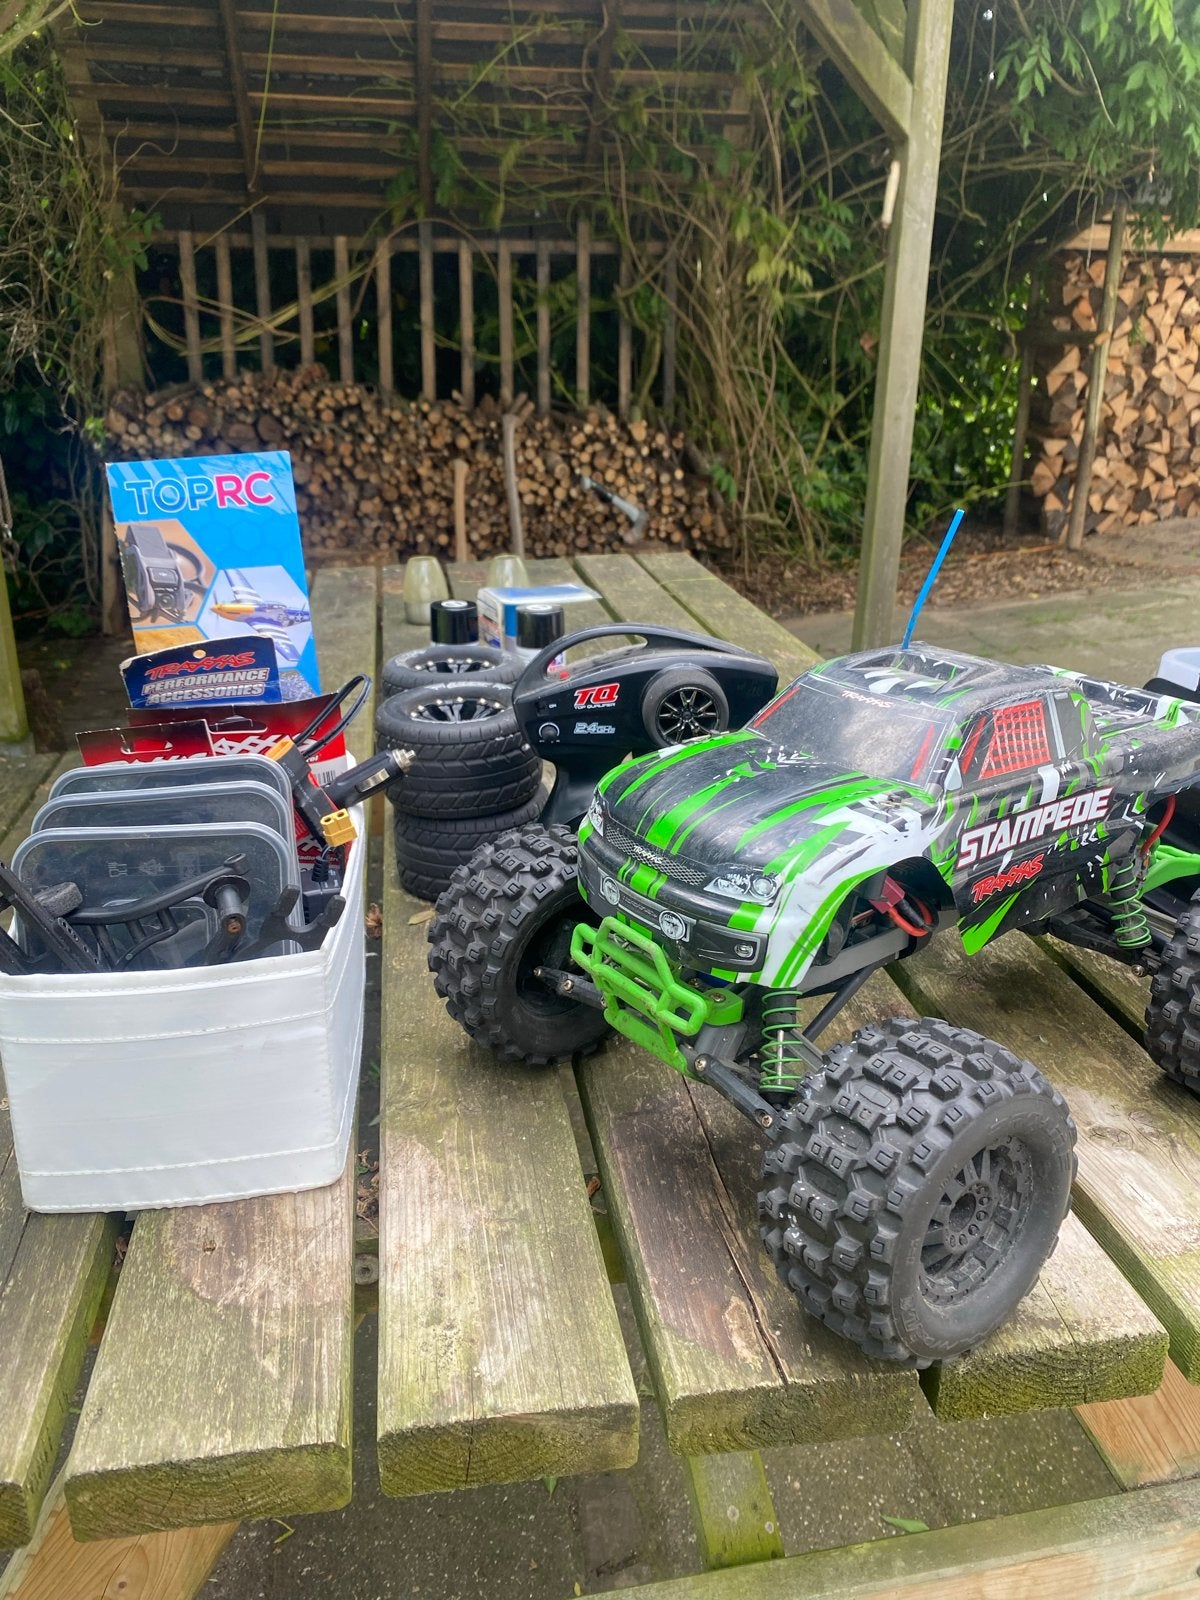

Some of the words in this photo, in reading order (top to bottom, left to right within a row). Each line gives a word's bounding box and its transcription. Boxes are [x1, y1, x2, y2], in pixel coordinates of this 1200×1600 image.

[125, 471, 275, 514] TOPRC
[145, 652, 256, 680] TRAXXAS
[142, 668, 270, 695] PERFORMANCE
[146, 683, 265, 706] ACCESSORIES
[573, 683, 620, 705] TQ
[841, 689, 894, 709] TRAXXAS
[956, 786, 1115, 870] STAMPEDE
[971, 853, 1045, 904] TRAXXAS
